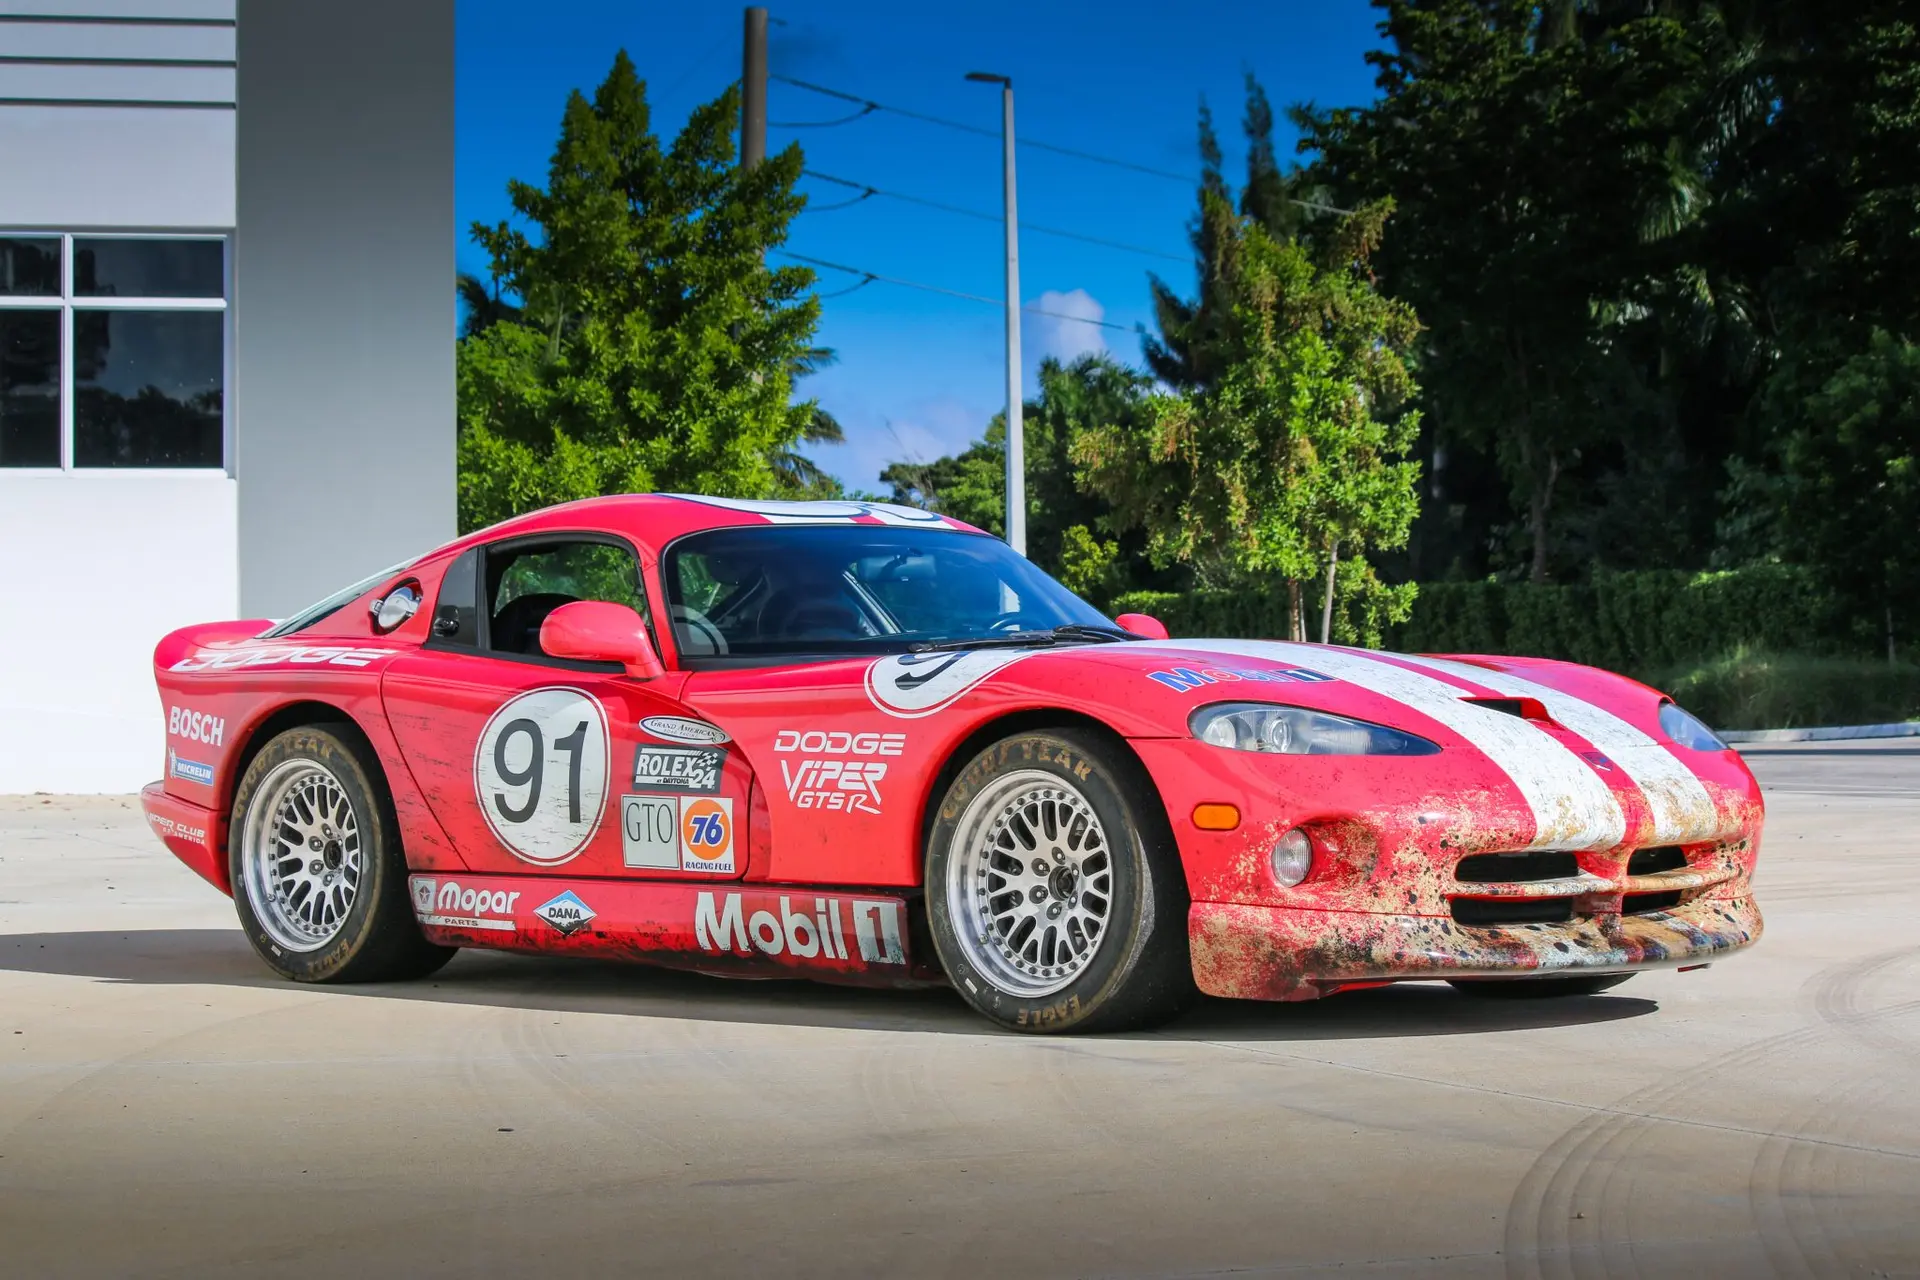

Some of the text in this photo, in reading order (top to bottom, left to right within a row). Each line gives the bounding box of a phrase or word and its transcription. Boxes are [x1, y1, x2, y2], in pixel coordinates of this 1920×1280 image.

[168, 705, 225, 747] BOSCH
[650, 720, 716, 737] GRAND AMERICAN
[774, 730, 906, 756] DODGE
[177, 762, 212, 779] MICHELIN
[494, 718, 589, 824] 91
[637, 754, 717, 789] ROLEX 24
[663, 776, 690, 785] DAYTONA
[780, 759, 888, 806] VIPER
[177, 823, 205, 838] CLUB
[625, 802, 673, 844] GTO
[690, 812, 724, 847] 76
[685, 861, 733, 871] RACING FUEL
[437, 882, 520, 916] Mopar
[548, 906, 581, 920] DANA
[444, 918, 478, 927] PARTS
[695, 892, 849, 960] Mobil
